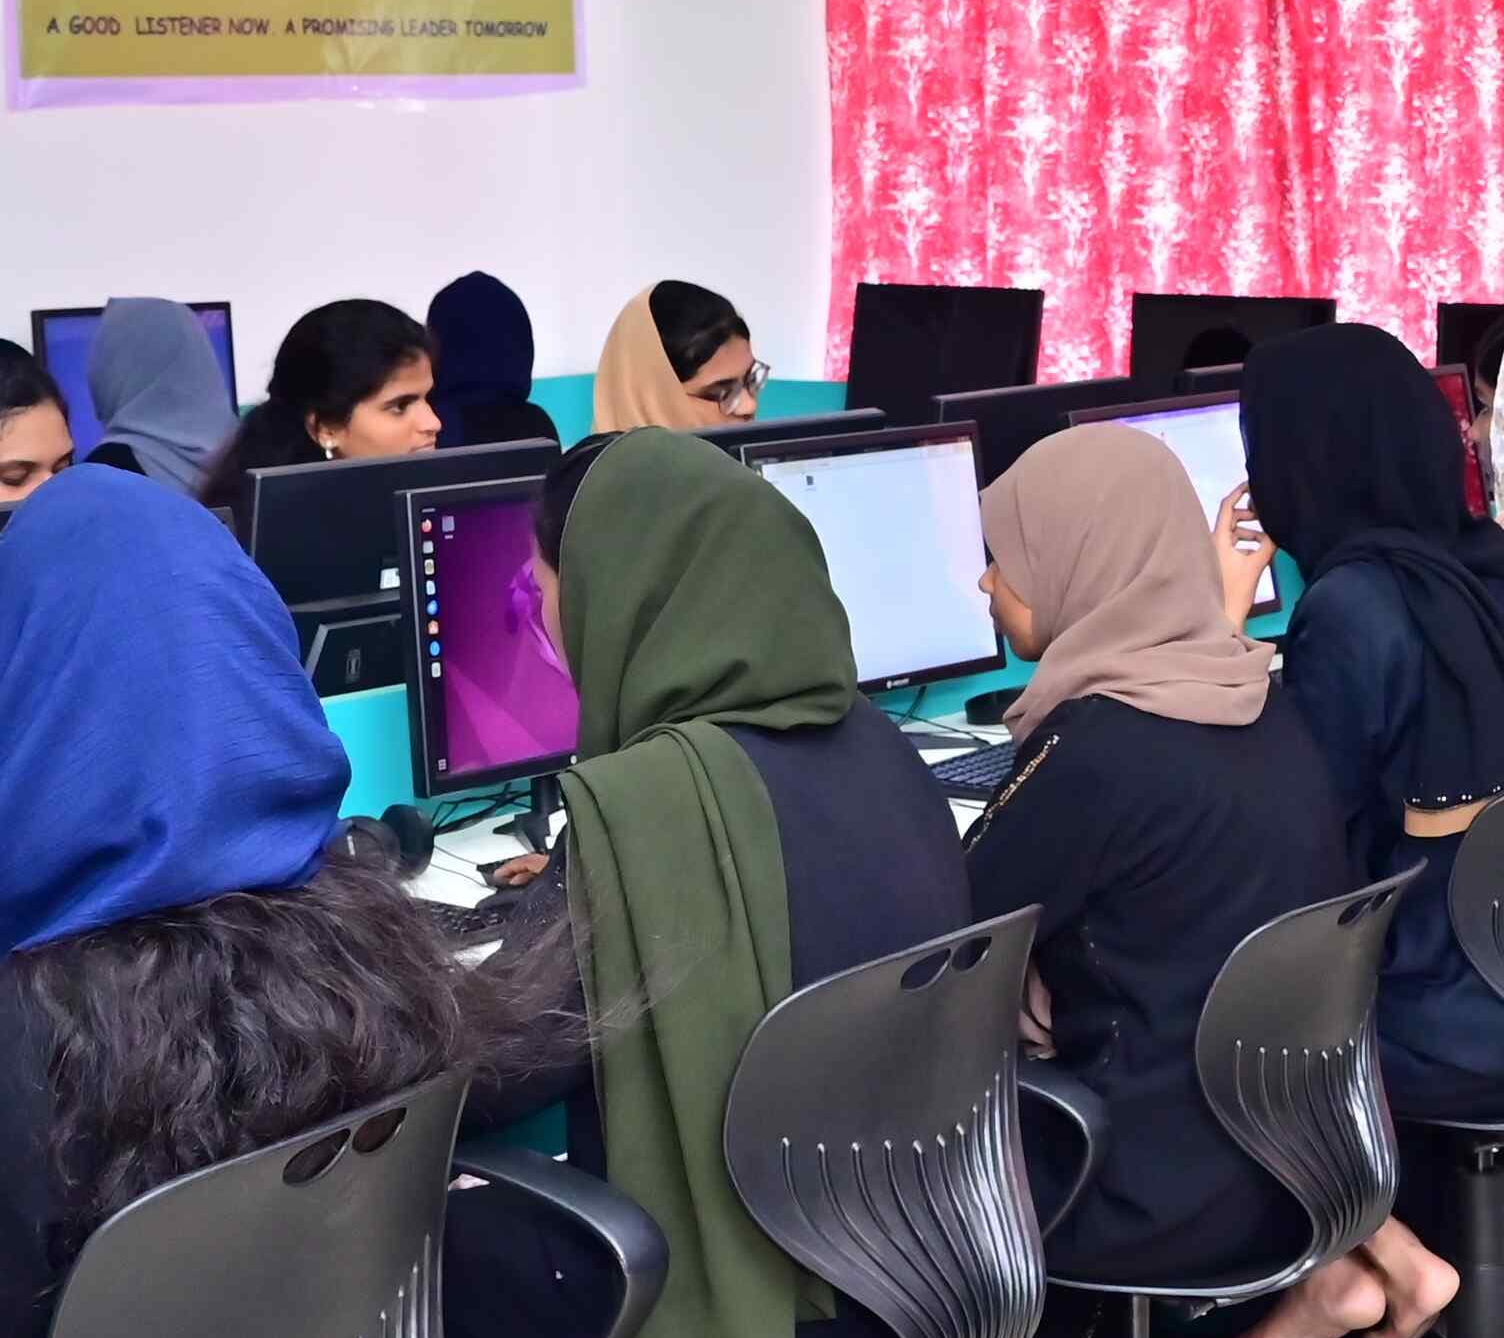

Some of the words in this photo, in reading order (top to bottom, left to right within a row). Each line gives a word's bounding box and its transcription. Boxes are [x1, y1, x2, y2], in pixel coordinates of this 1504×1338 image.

[46, 18, 60, 35] A
[69, 16, 121, 36] GOOD
[136, 17, 222, 36] LISTENER
[284, 18, 296, 35] A
[302, 18, 396, 36] PROMISING
[401, 20, 458, 37] LEADER
[465, 21, 548, 38] TOMORROW
